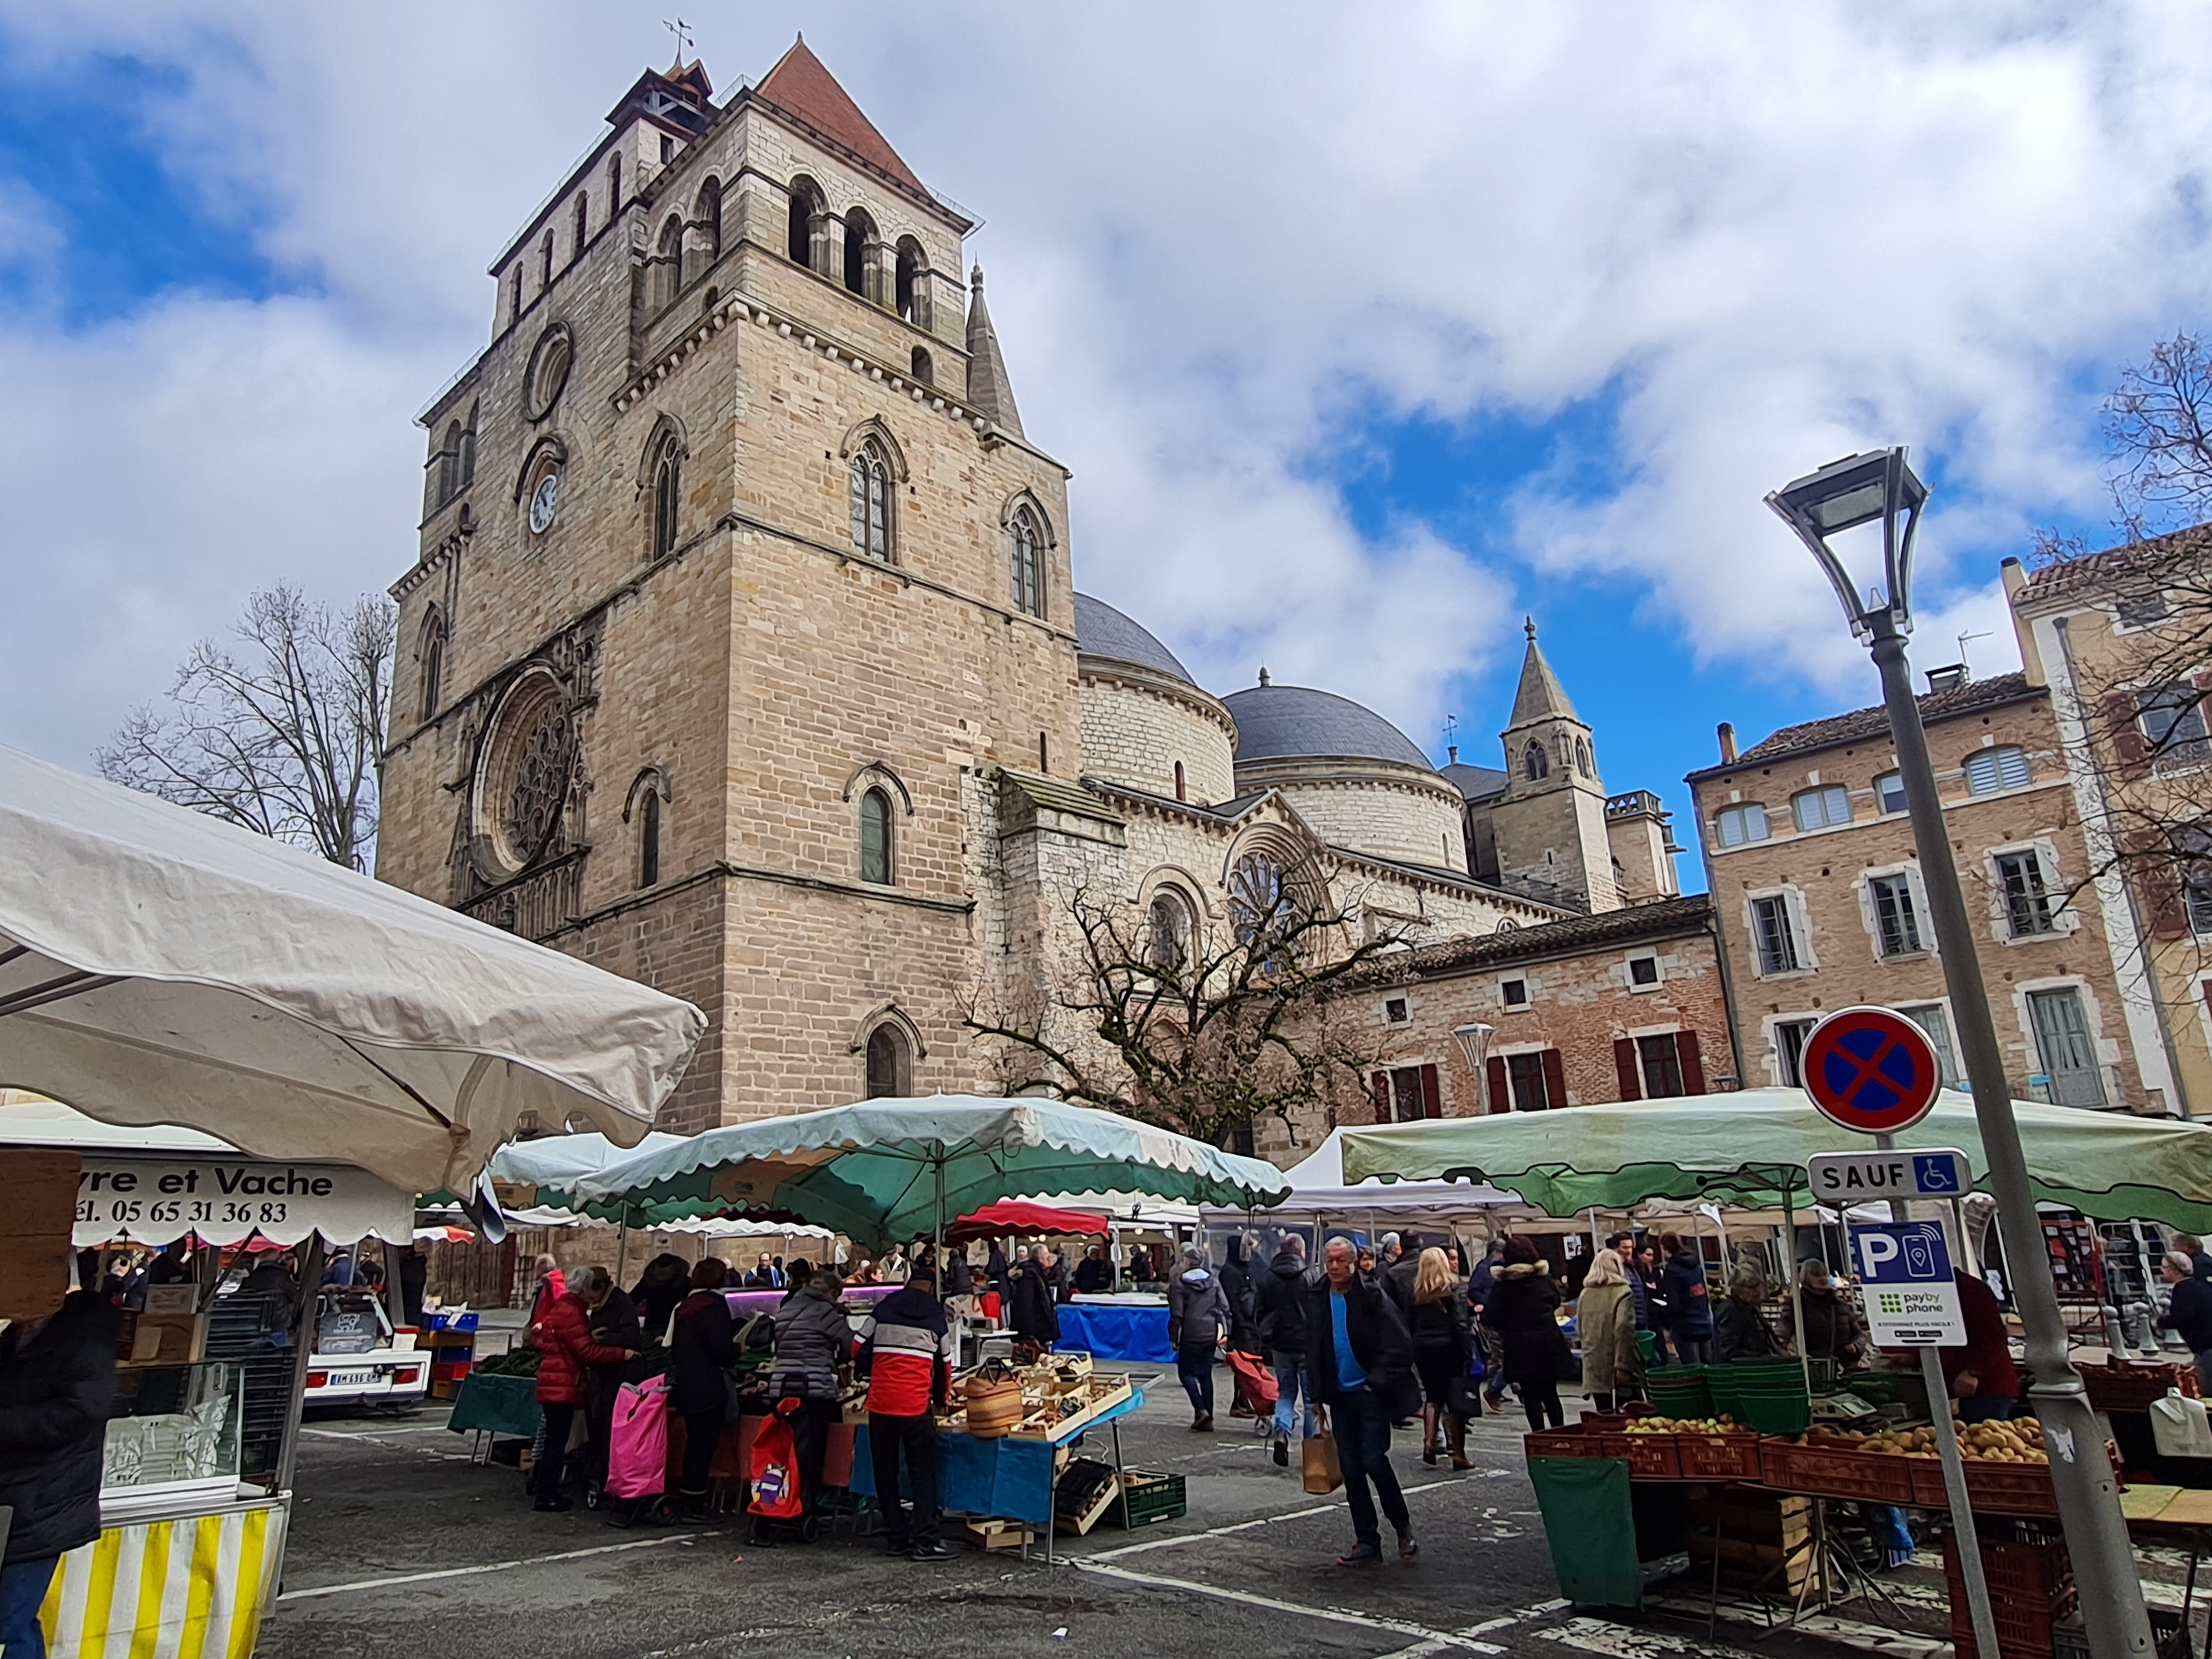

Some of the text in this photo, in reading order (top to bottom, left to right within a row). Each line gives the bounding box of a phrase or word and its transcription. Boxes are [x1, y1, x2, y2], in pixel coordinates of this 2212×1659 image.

[158, 1169, 200, 1194] et
[215, 1167, 333, 1197] Vache
[1822, 1163, 1904, 1189] SAUF
[111, 1200, 143, 1222] 05
[150, 1200, 182, 1222] 65
[188, 1201, 213, 1222] 31
[221, 1202, 253, 1223] 36
[259, 1202, 287, 1223] 83
[1858, 1233, 1899, 1278] P
[1903, 1292, 1940, 1304] payby
[1906, 1304, 1943, 1314] phone
